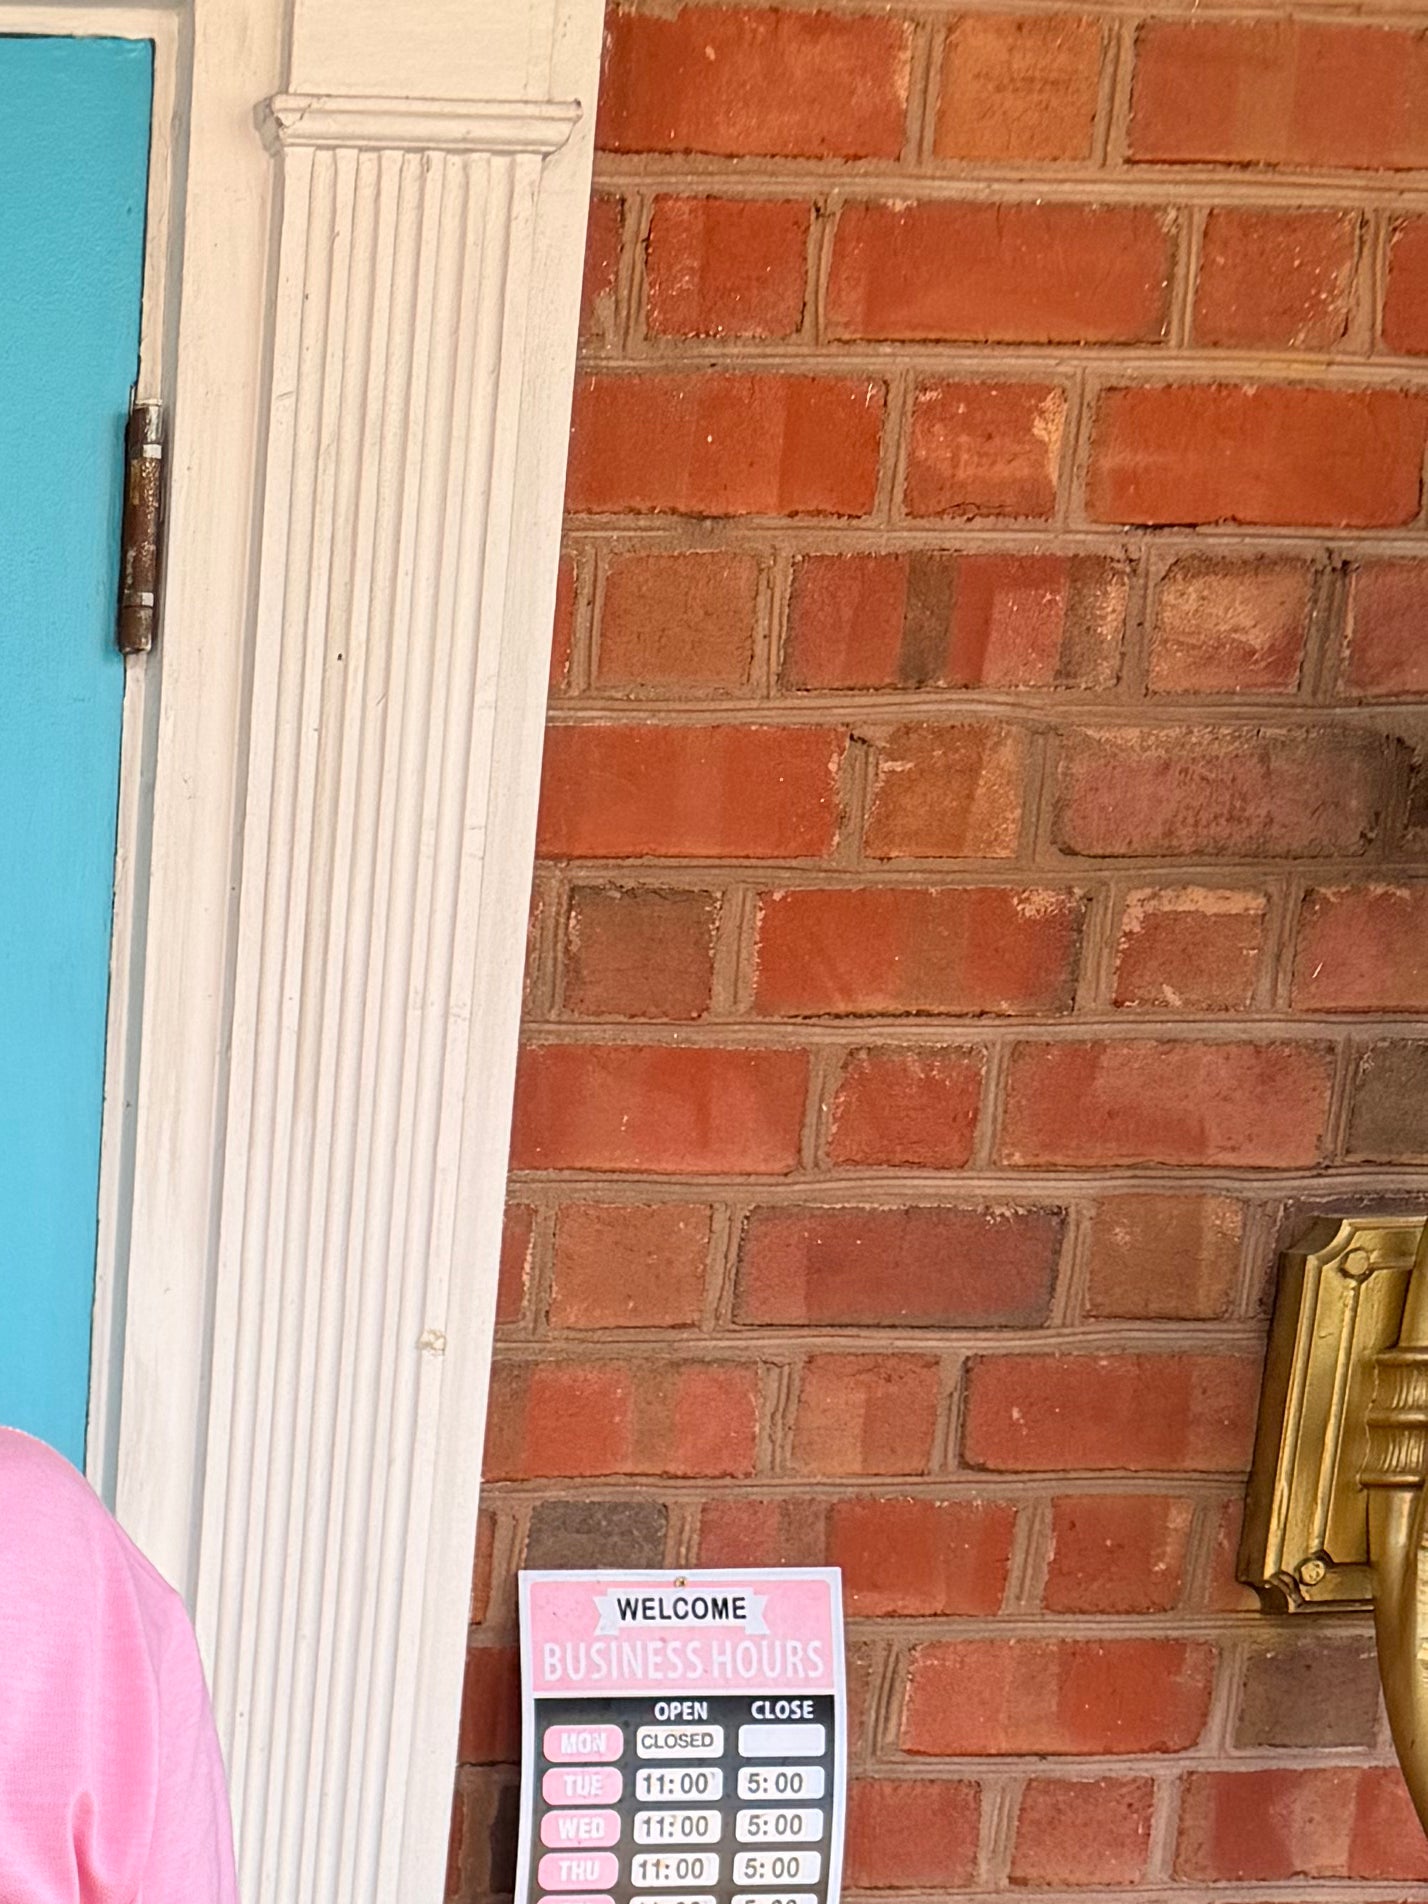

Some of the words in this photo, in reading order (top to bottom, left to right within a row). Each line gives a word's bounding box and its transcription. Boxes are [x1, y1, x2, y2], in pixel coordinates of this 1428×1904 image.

[617, 1597, 746, 1620] WELCOME
[544, 1641, 703, 1681] BUSINESS
[712, 1639, 825, 1679] HOURS
[654, 1701, 708, 1721] OPEN
[751, 1700, 814, 1719] CLOSE
[560, 1732, 607, 1754] MON
[641, 1732, 714, 1750] CLOSED
[564, 1774, 603, 1797] TUE
[643, 1772, 709, 1795] 11:00
[747, 1772, 804, 1794] 5:00
[558, 1817, 604, 1840] WED
[643, 1815, 709, 1838] 11:00
[747, 1814, 803, 1836] 5:00
[559, 1859, 600, 1881] THU
[638, 1857, 704, 1880] 11:00
[744, 1857, 800, 1879] 5:00
